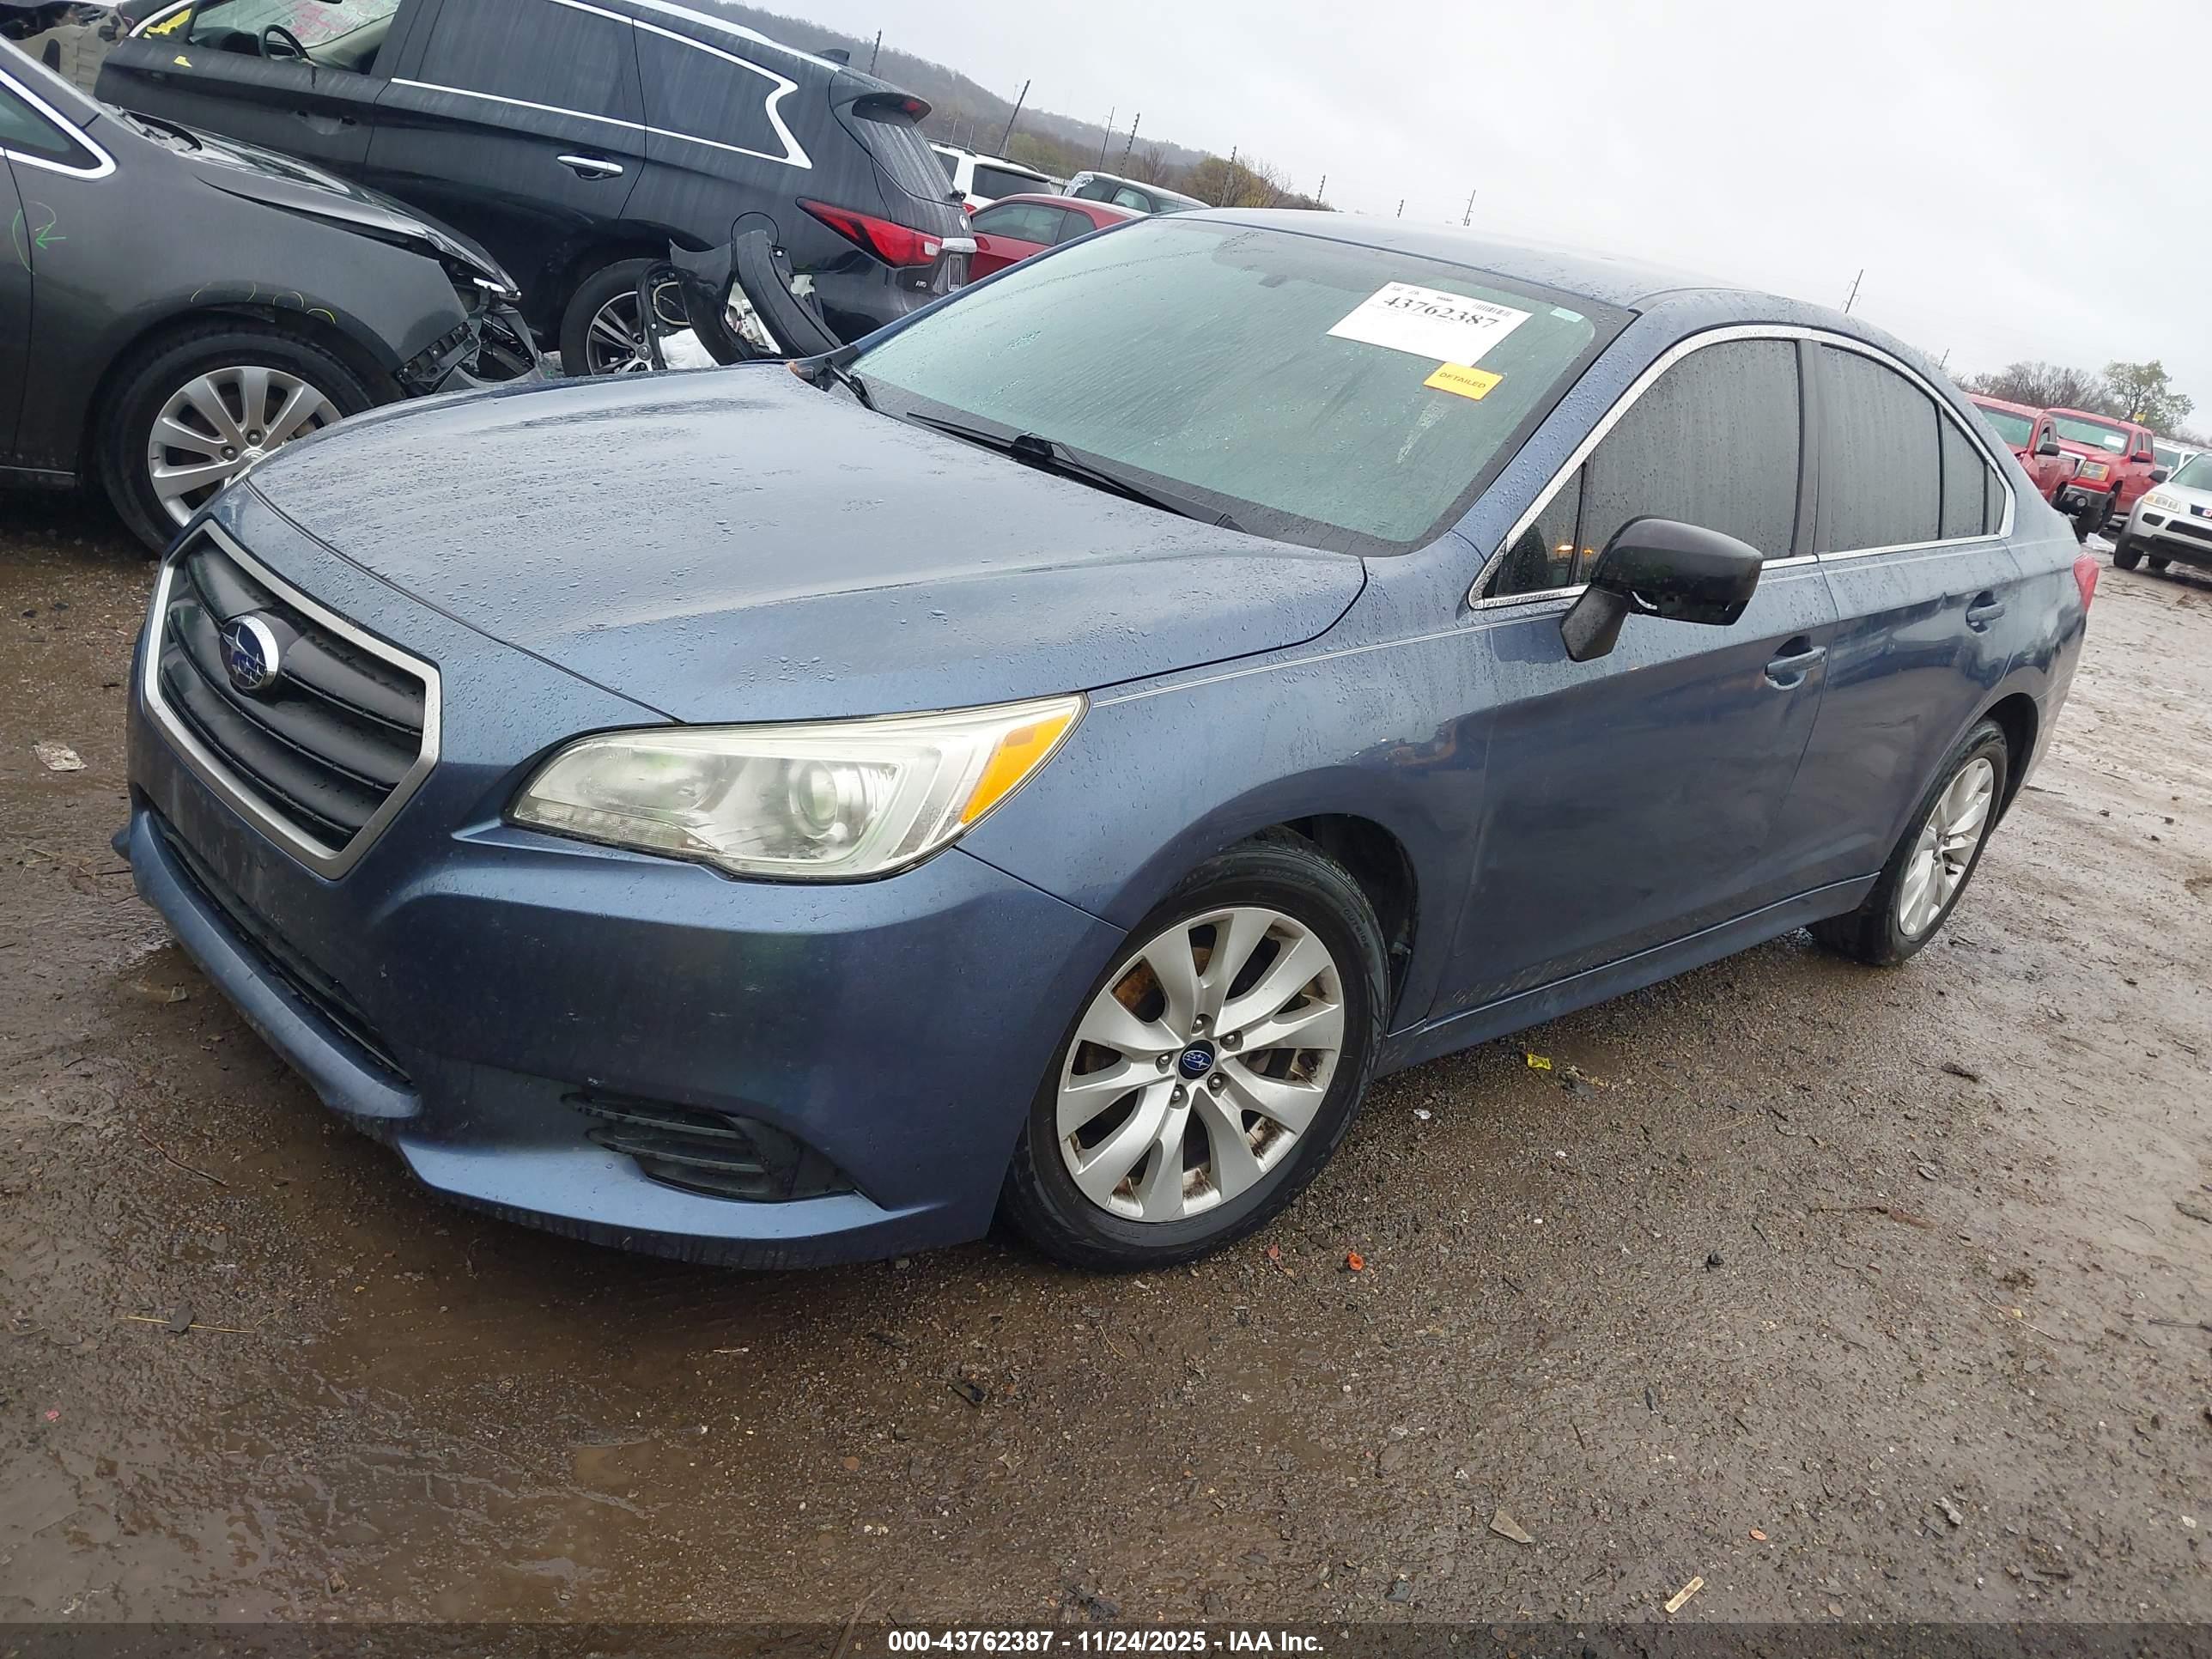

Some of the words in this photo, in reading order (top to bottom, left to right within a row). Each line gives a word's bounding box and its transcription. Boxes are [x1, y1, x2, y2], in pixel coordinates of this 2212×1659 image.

[1383, 296, 1499, 328] 43762387
[1439, 372, 1486, 388] DETAILED
[1343, 908, 1370, 948] OUTSIDE
